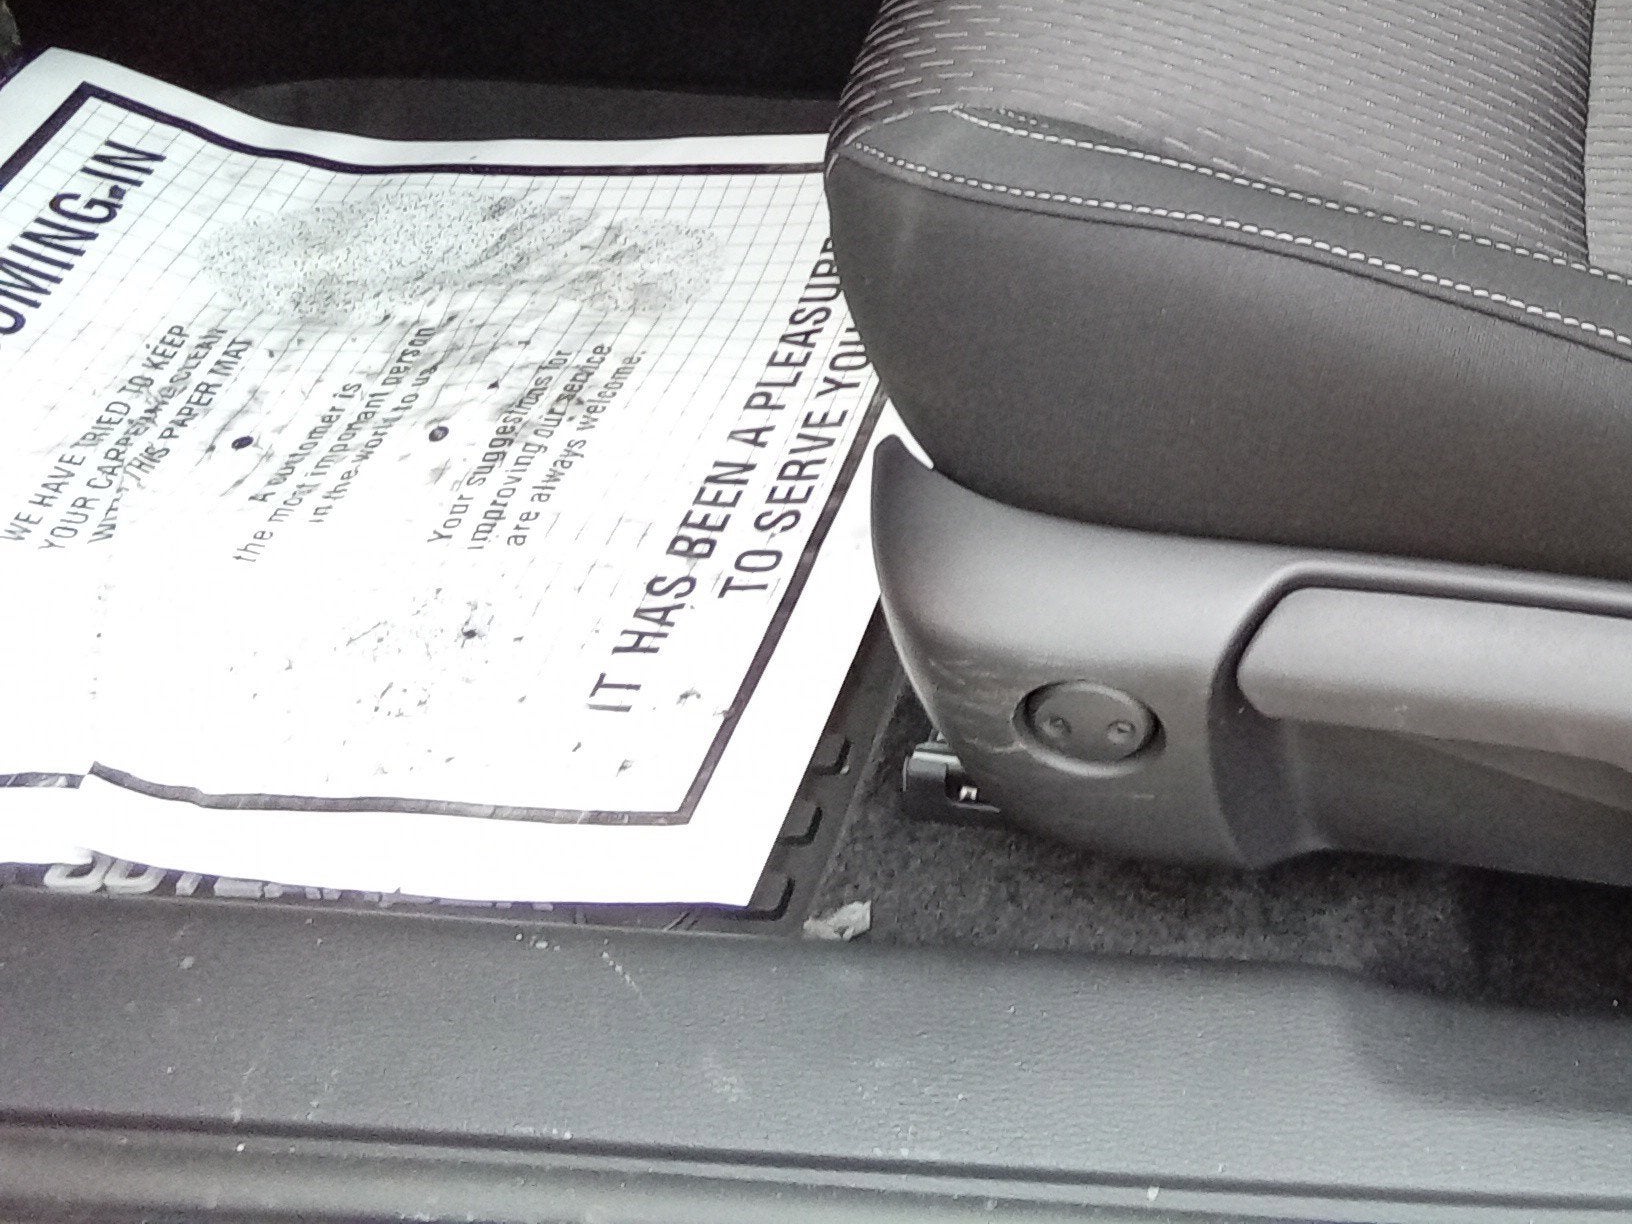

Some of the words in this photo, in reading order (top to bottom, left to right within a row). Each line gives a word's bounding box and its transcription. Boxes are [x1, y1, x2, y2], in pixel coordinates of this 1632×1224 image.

[743, 237, 842, 411] PLEASUR
[0, 511, 43, 542] WE
[28, 454, 86, 507] HAVE
[70, 401, 131, 449] TRIED
[117, 375, 155, 394] TO
[142, 325, 190, 371] KEEP
[123, 443, 170, 482] THIS
[158, 381, 222, 440] PAPER
[207, 338, 253, 376] MAT
[233, 530, 273, 563] the
[267, 483, 320, 522] most
[304, 390, 394, 476] important
[381, 327, 436, 386] person
[248, 491, 276, 502] A
[267, 407, 345, 486] customer
[333, 382, 362, 399] is
[308, 505, 333, 522] in
[322, 470, 358, 500] the
[351, 414, 404, 463] world
[391, 392, 419, 412] to
[427, 494, 474, 543] Your
[466, 375, 554, 487] suggestions
[538, 350, 572, 372] for
[467, 442, 549, 550] improving
[533, 408, 567, 439] our
[556, 343, 612, 402] service
[727, 425, 775, 447] A
[38, 496, 100, 550] YOUR
[507, 510, 540, 546] are
[530, 439, 587, 502] always
[666, 460, 758, 560] BEEN
[717, 549, 784, 599] TO
[754, 410, 848, 533] SERVE
[611, 575, 697, 656] HAS
[586, 672, 641, 713] IT
